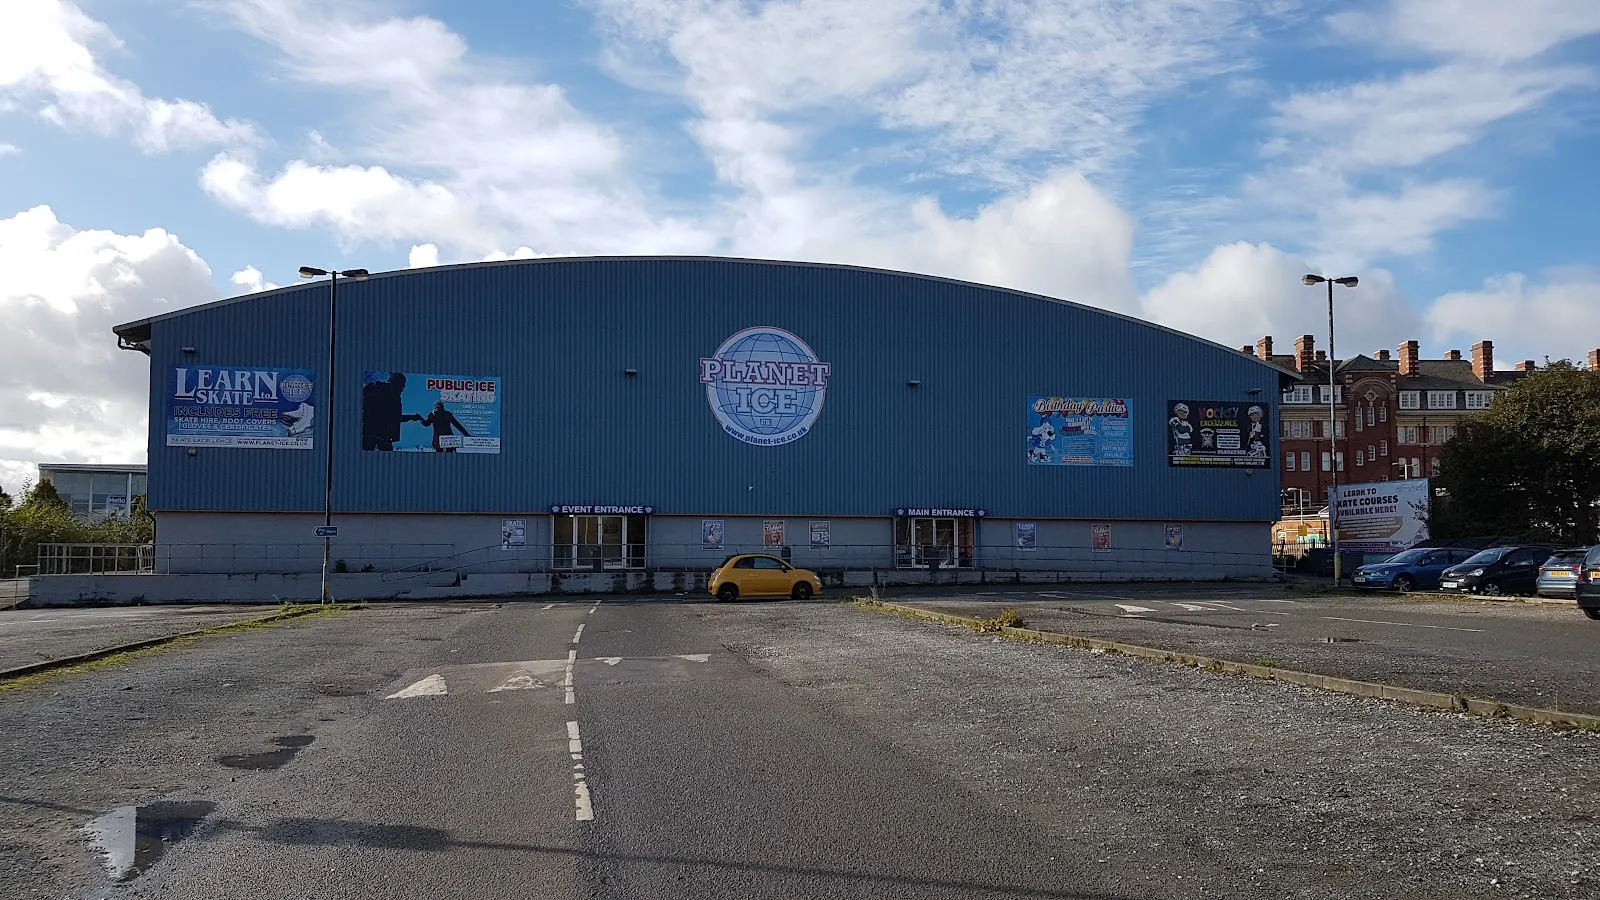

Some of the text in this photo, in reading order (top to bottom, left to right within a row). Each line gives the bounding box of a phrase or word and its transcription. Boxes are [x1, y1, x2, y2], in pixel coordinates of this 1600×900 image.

[701, 358, 830, 387] PLANET
[174, 367, 279, 400] LEARN to
[427, 379, 496, 392] PUBLIC ICE
[195, 390, 253, 406] SKATE
[441, 391, 497, 404] SKATING
[736, 387, 798, 415] ICE
[173, 406, 278, 419] INCLUDES FREE
[1034, 399, 1127, 414] Birthday Parties
[725, 424, 808, 445] www.planet-ice.co.uk
[1343, 489, 1366, 498] LEARN
[1359, 495, 1399, 506] COURSES
[594, 506, 644, 514] ENTRANCE
[908, 508, 975, 517] MAIN ENTRANCE
[1374, 505, 1397, 514] HERE!
